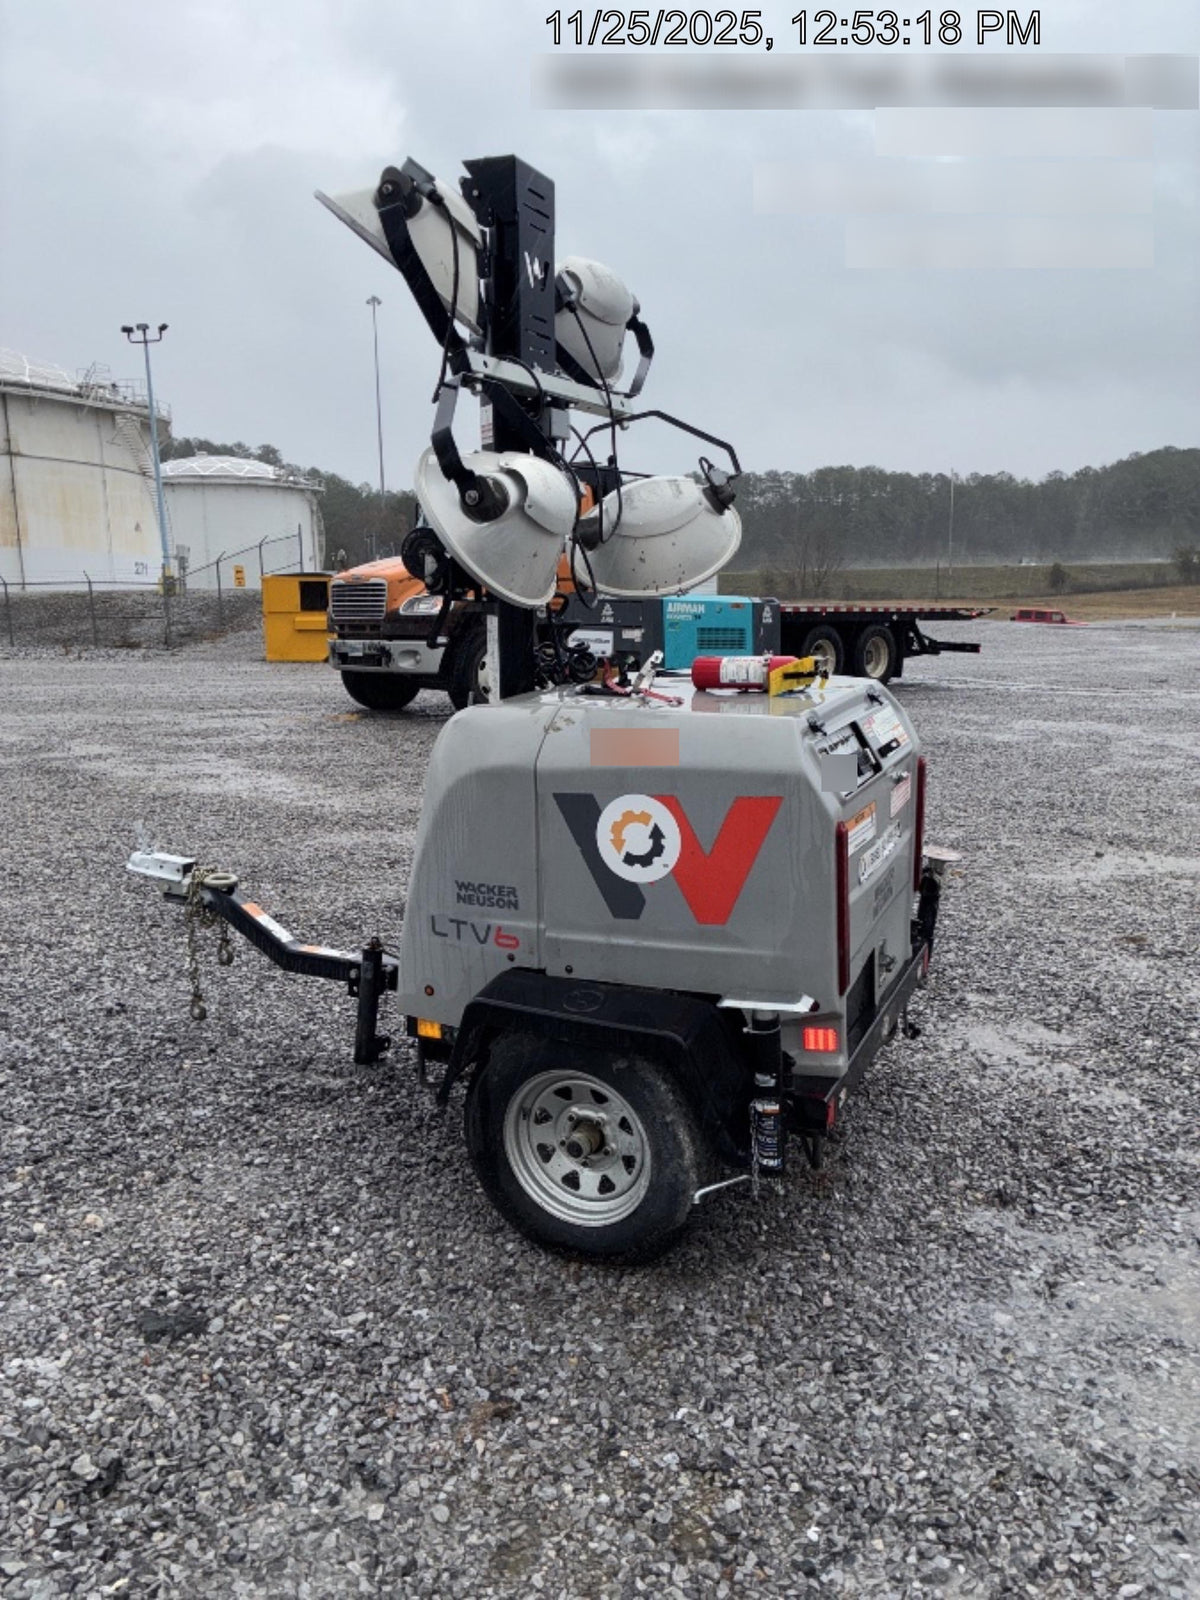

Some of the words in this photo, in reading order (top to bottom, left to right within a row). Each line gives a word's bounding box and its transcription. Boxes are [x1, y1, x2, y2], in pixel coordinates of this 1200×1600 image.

[667, 601, 706, 614] AIRMAN
[455, 880, 519, 899] WACKER
[456, 892, 519, 911] NEUSON
[431, 915, 520, 950] LTV6
